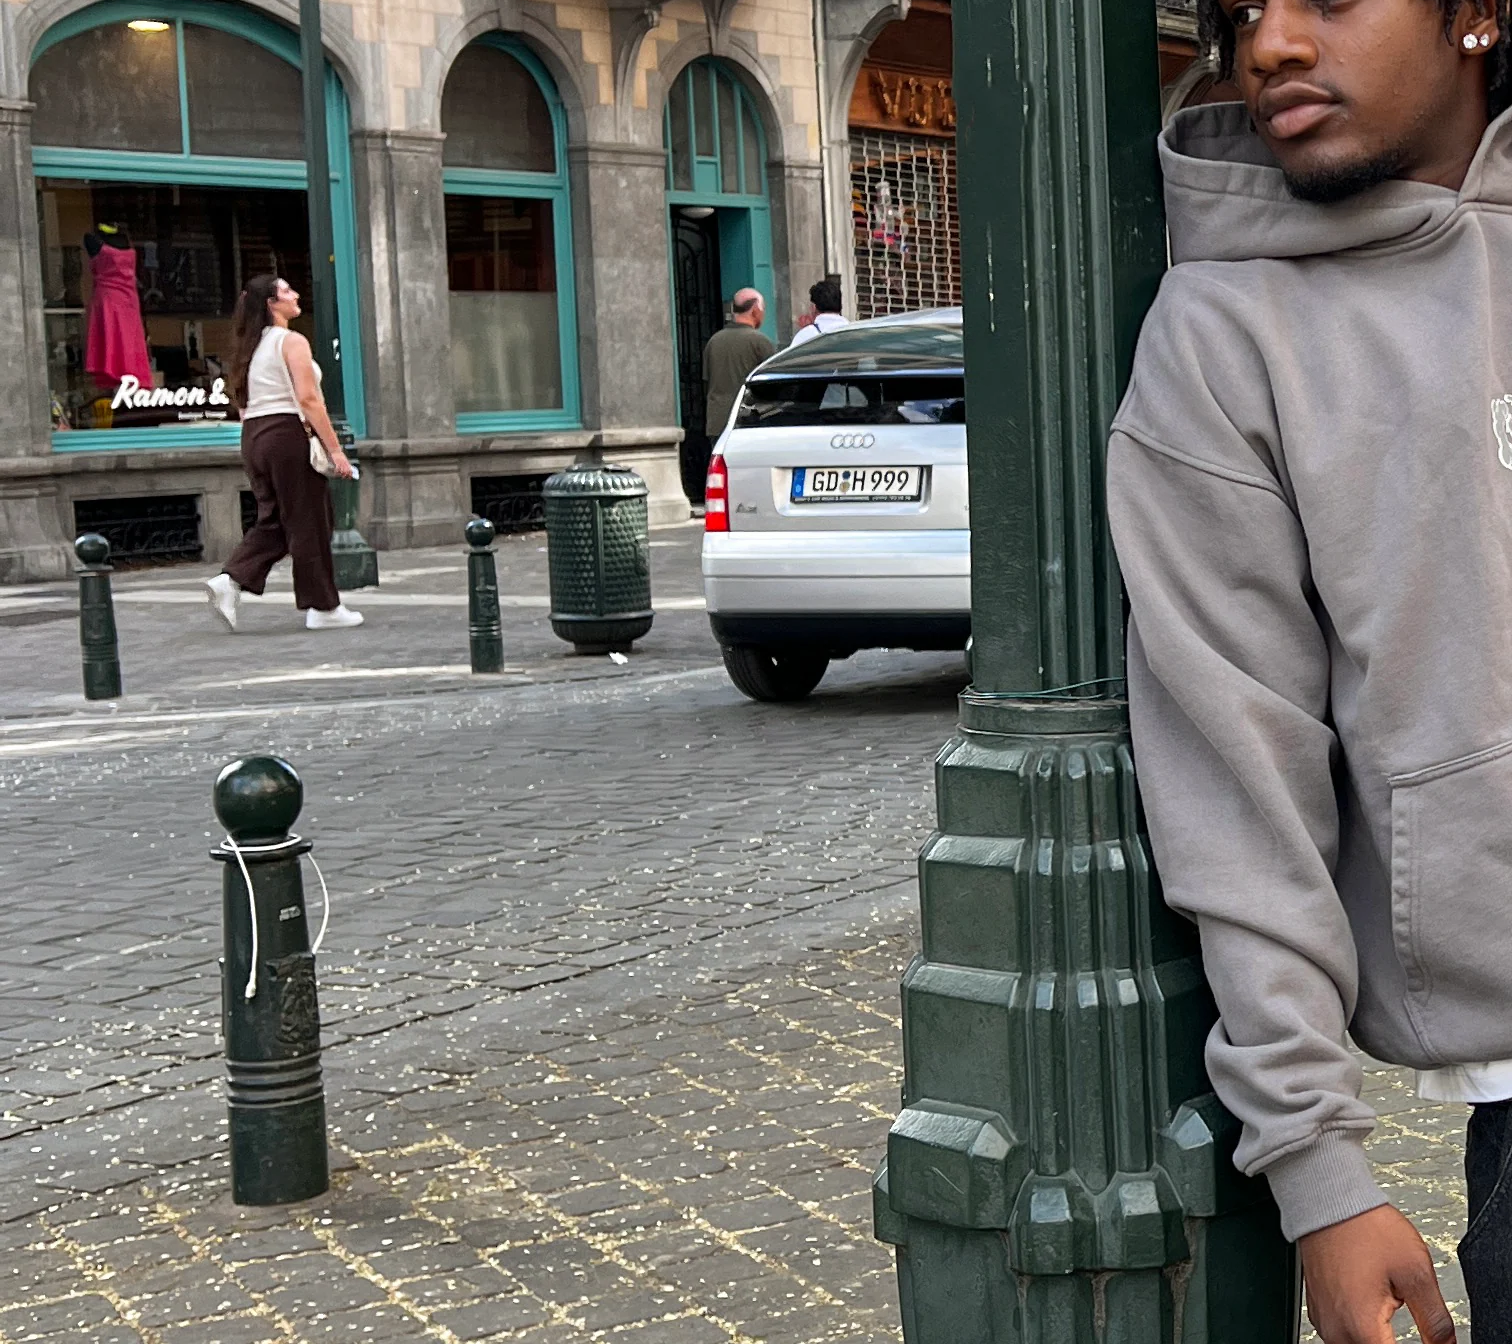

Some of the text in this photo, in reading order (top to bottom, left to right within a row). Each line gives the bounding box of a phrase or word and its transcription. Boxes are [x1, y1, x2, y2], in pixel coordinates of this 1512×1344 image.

[111, 375, 230, 409] Ramon &
[812, 470, 909, 492] GD H 999
